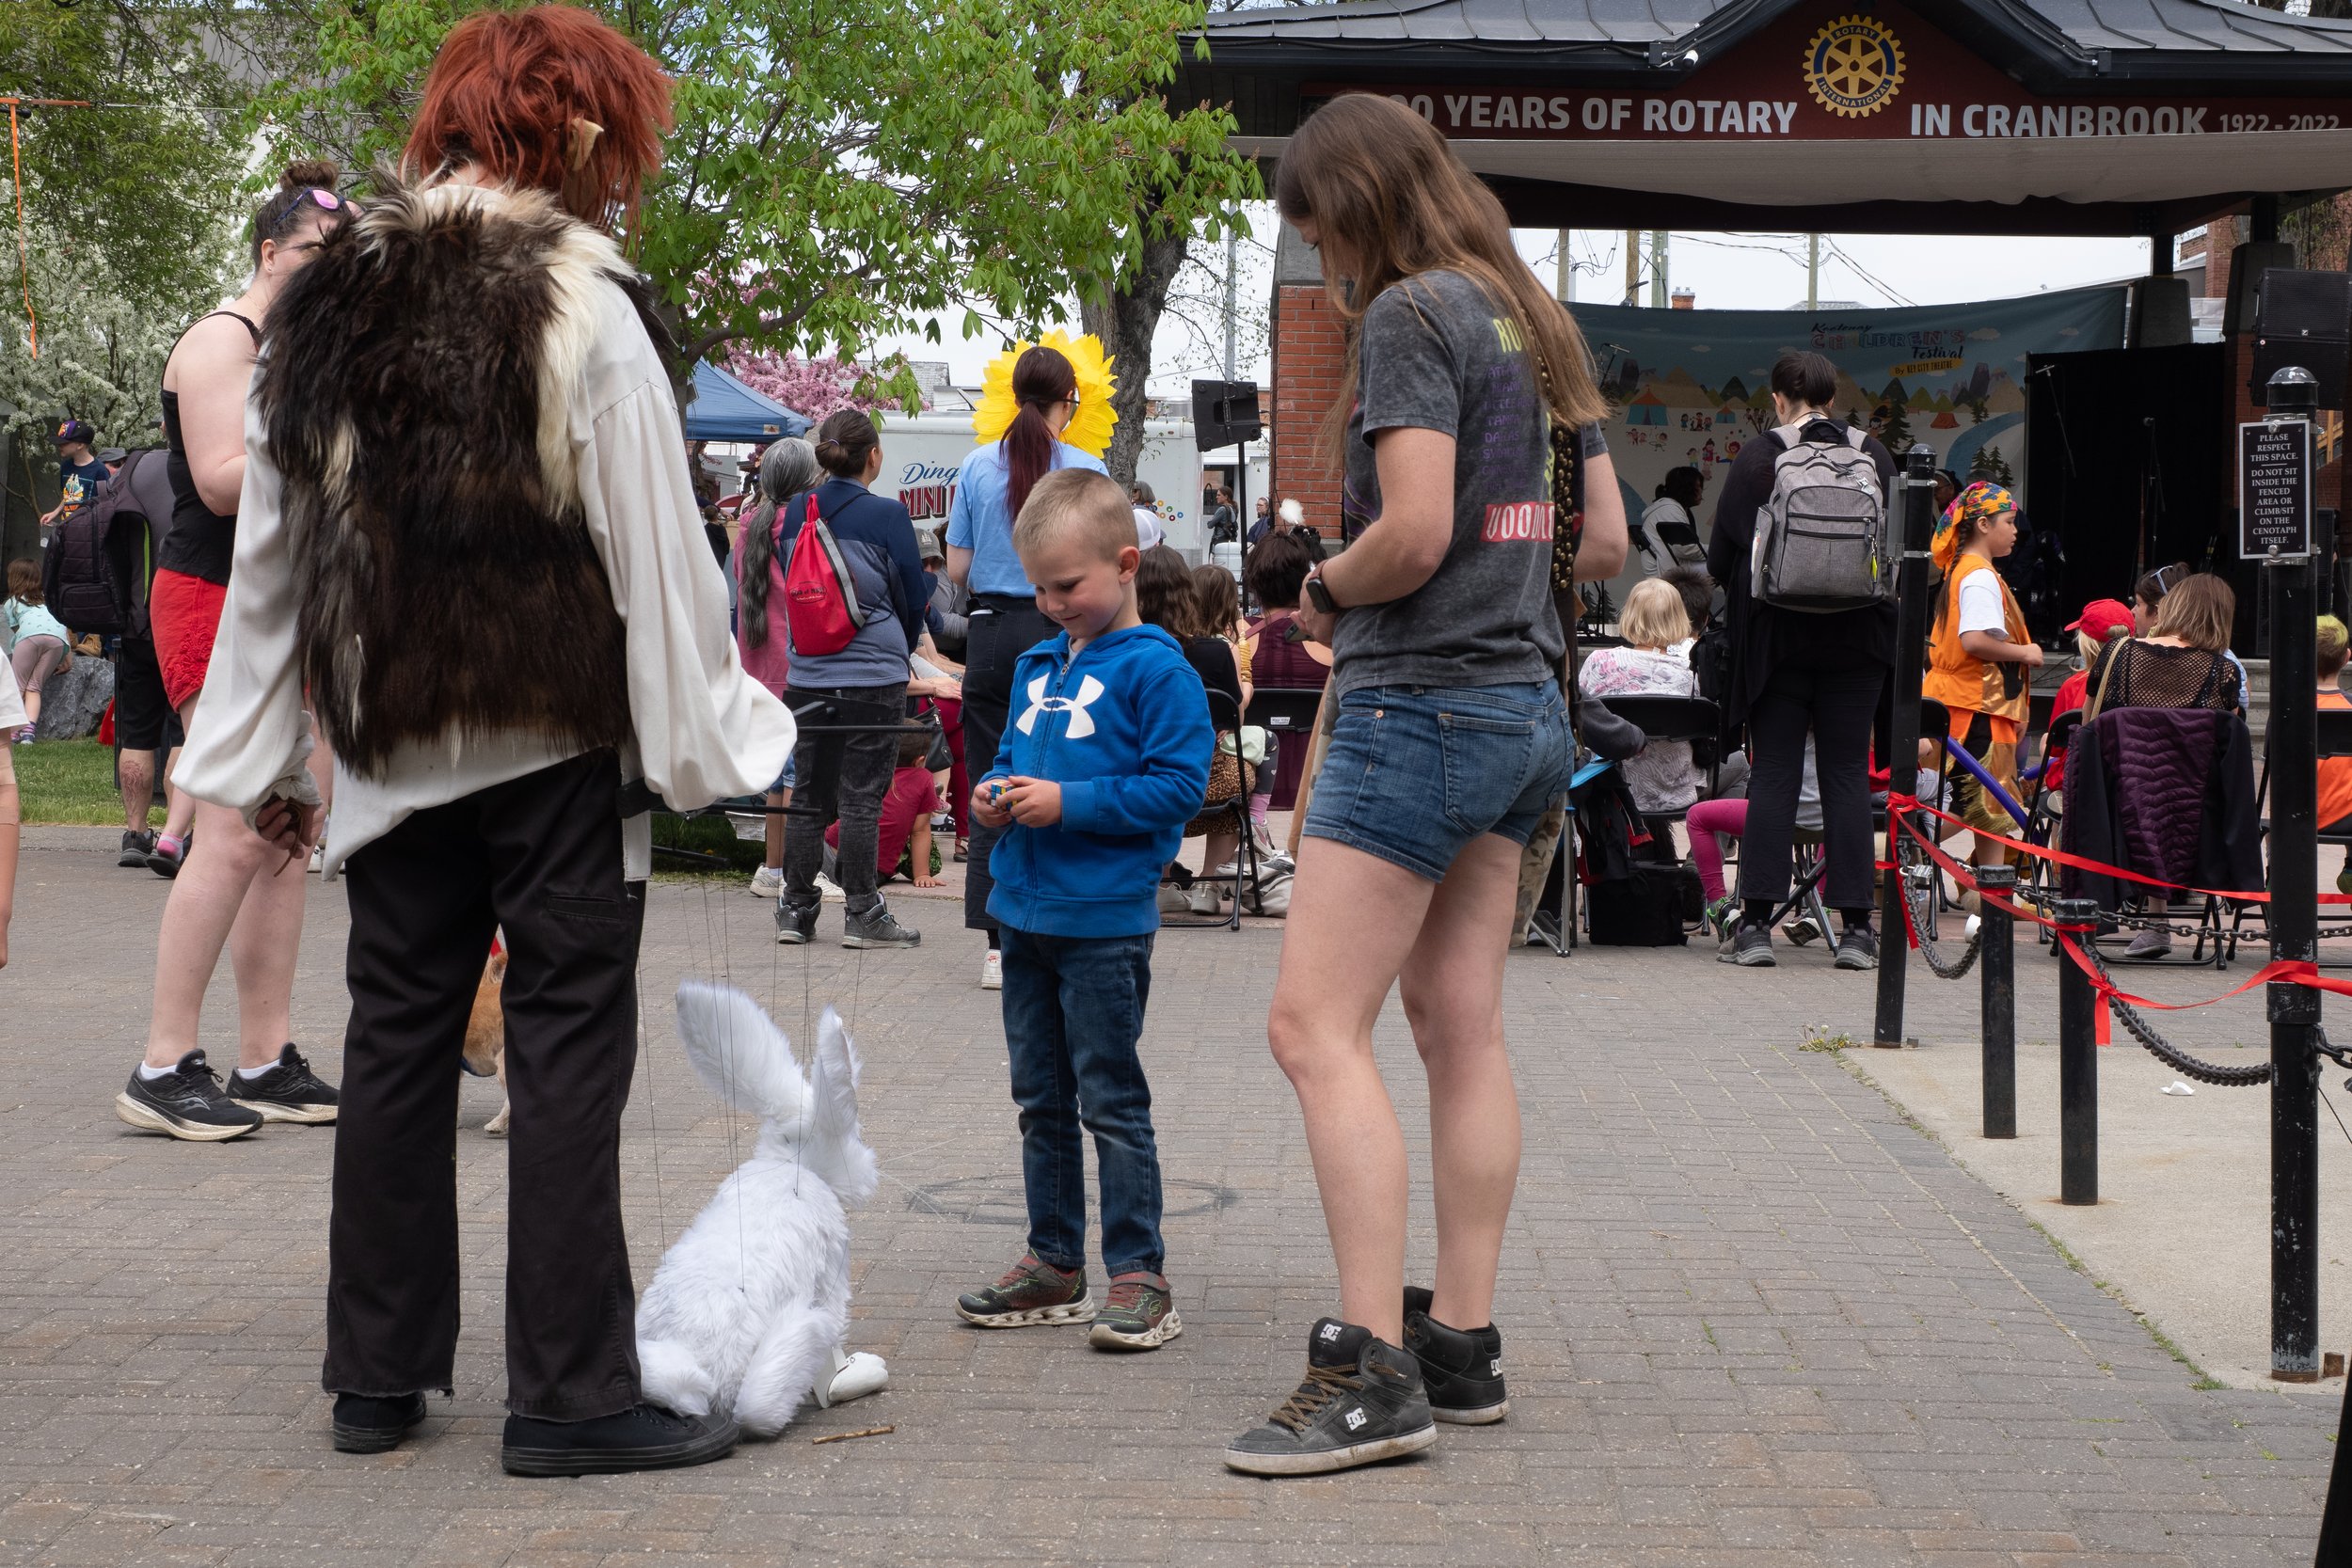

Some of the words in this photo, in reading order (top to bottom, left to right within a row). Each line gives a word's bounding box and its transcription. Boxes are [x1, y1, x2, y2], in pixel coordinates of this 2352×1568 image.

[1836, 26, 1876, 38] ROTARY
[1819, 80, 1890, 107] INTERNATIONAL
[1444, 96, 1570, 130] YEARS
[1582, 97, 1632, 131] OF
[1644, 99, 1798, 134] ROTARY
[1911, 103, 1950, 136] IN
[1963, 104, 2208, 137] CRANBROOK
[2219, 114, 2269, 133] 1922
[2289, 114, 2340, 131] 2022
[1912, 345, 1964, 360] Festival
[1895, 367, 1905, 375] By
[1917, 362, 1929, 372] CITY
[1931, 359, 1953, 371] THEATRE
[2260, 434, 2289, 442] PLEASE
[2257, 443, 2292, 451] RESPECT
[2271, 452, 2298, 461] SPACE.
[899, 460, 960, 486] Ding
[2284, 467, 2297, 476] SIT
[2251, 478, 2280, 486] INSIDE
[2281, 477, 2297, 485] THE
[2259, 487, 2290, 496] FENCED
[898, 484, 946, 521] MINI
[2257, 498, 2279, 506] AREA
[2280, 497, 2292, 505] OR
[2254, 507, 2296, 515] CLIMB/SIT
[2274, 516, 2290, 525] THE
[2253, 526, 2296, 535] CENOTAPH
[2261, 536, 2289, 545] ITSELF.
